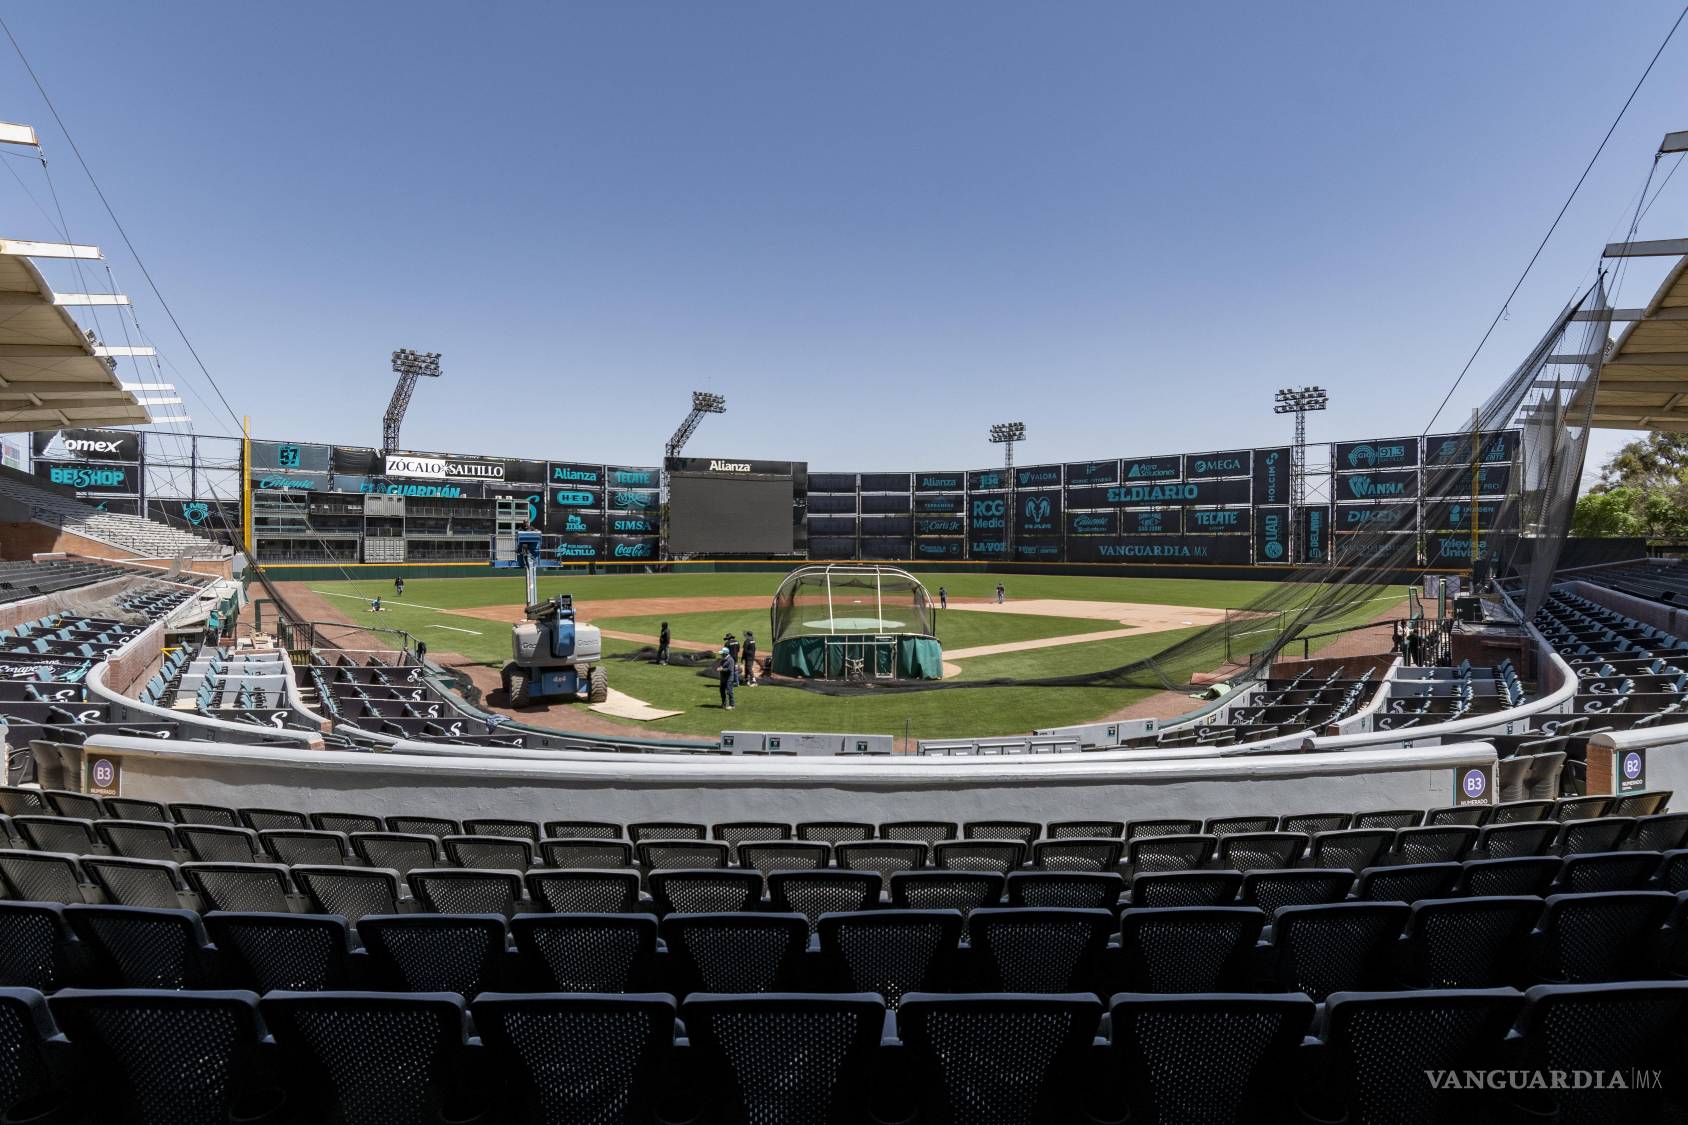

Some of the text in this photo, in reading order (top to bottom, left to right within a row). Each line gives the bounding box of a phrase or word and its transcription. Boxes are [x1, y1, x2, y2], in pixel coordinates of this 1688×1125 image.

[388, 458, 504, 477] ZÓCALO SALTILLO
[709, 460, 752, 472] Alianza
[554, 467, 597, 482] Alianza
[921, 477, 957, 487] Alianza
[1268, 466, 1277, 502] HOLCIM
[973, 499, 1005, 517] RCG
[973, 518, 1005, 529] Media
[1195, 511, 1239, 525] TECATE
[614, 520, 651, 531] SIMSA
[1439, 538, 1487, 548] Televia
[1097, 545, 1190, 557] VANGUARDIA
[1626, 760, 1639, 772] B2
[97, 767, 111, 780] B3
[1467, 777, 1482, 791] B3
